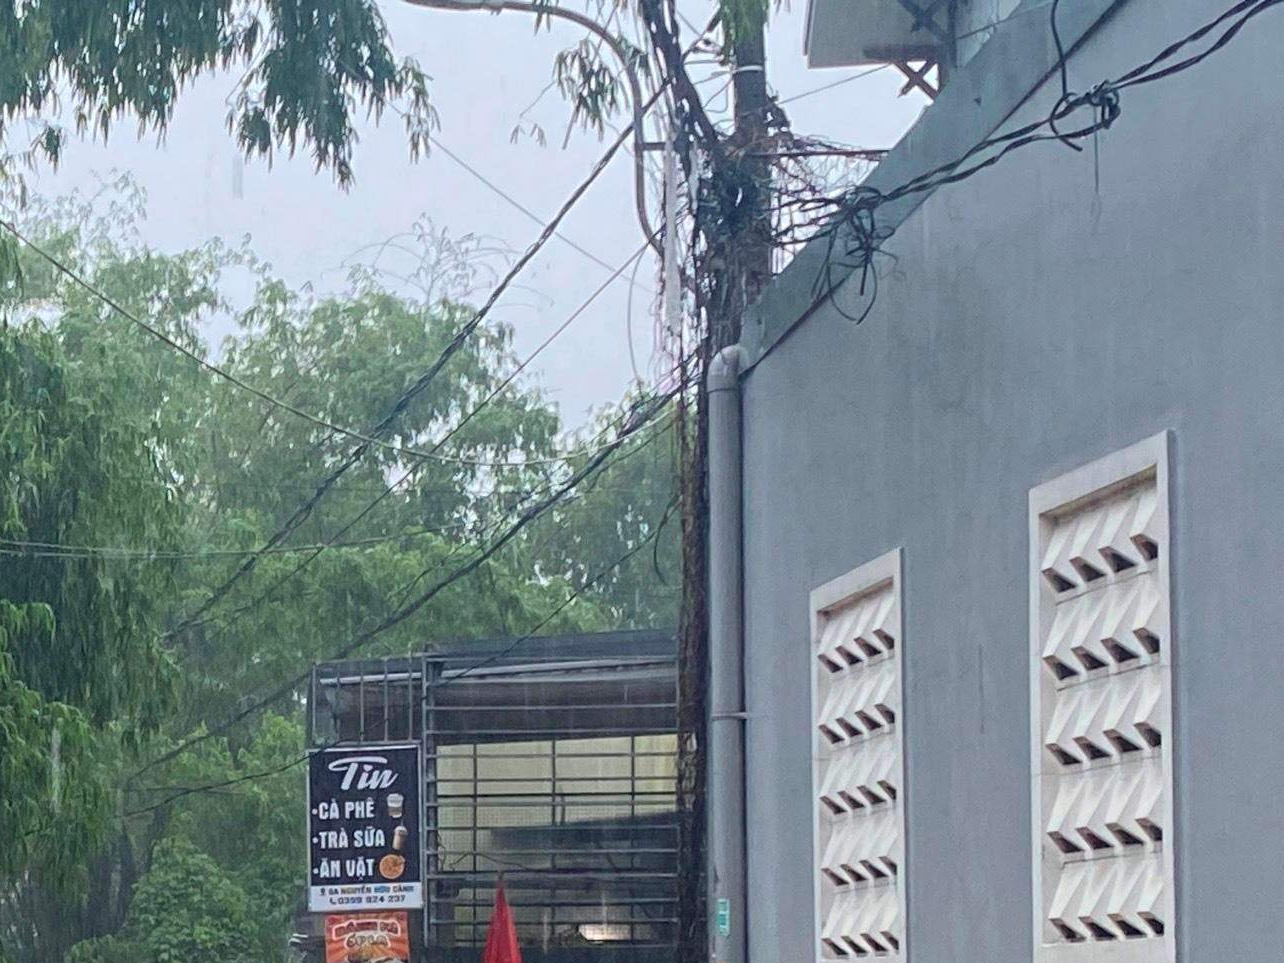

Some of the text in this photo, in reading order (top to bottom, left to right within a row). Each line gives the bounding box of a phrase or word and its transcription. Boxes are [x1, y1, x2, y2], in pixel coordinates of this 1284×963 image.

[328, 756, 398, 790] Tin
[318, 796, 375, 820] CÀ PHÊ
[318, 825, 385, 849] TRÀ SỮA
[319, 857, 341, 878] ĂN
